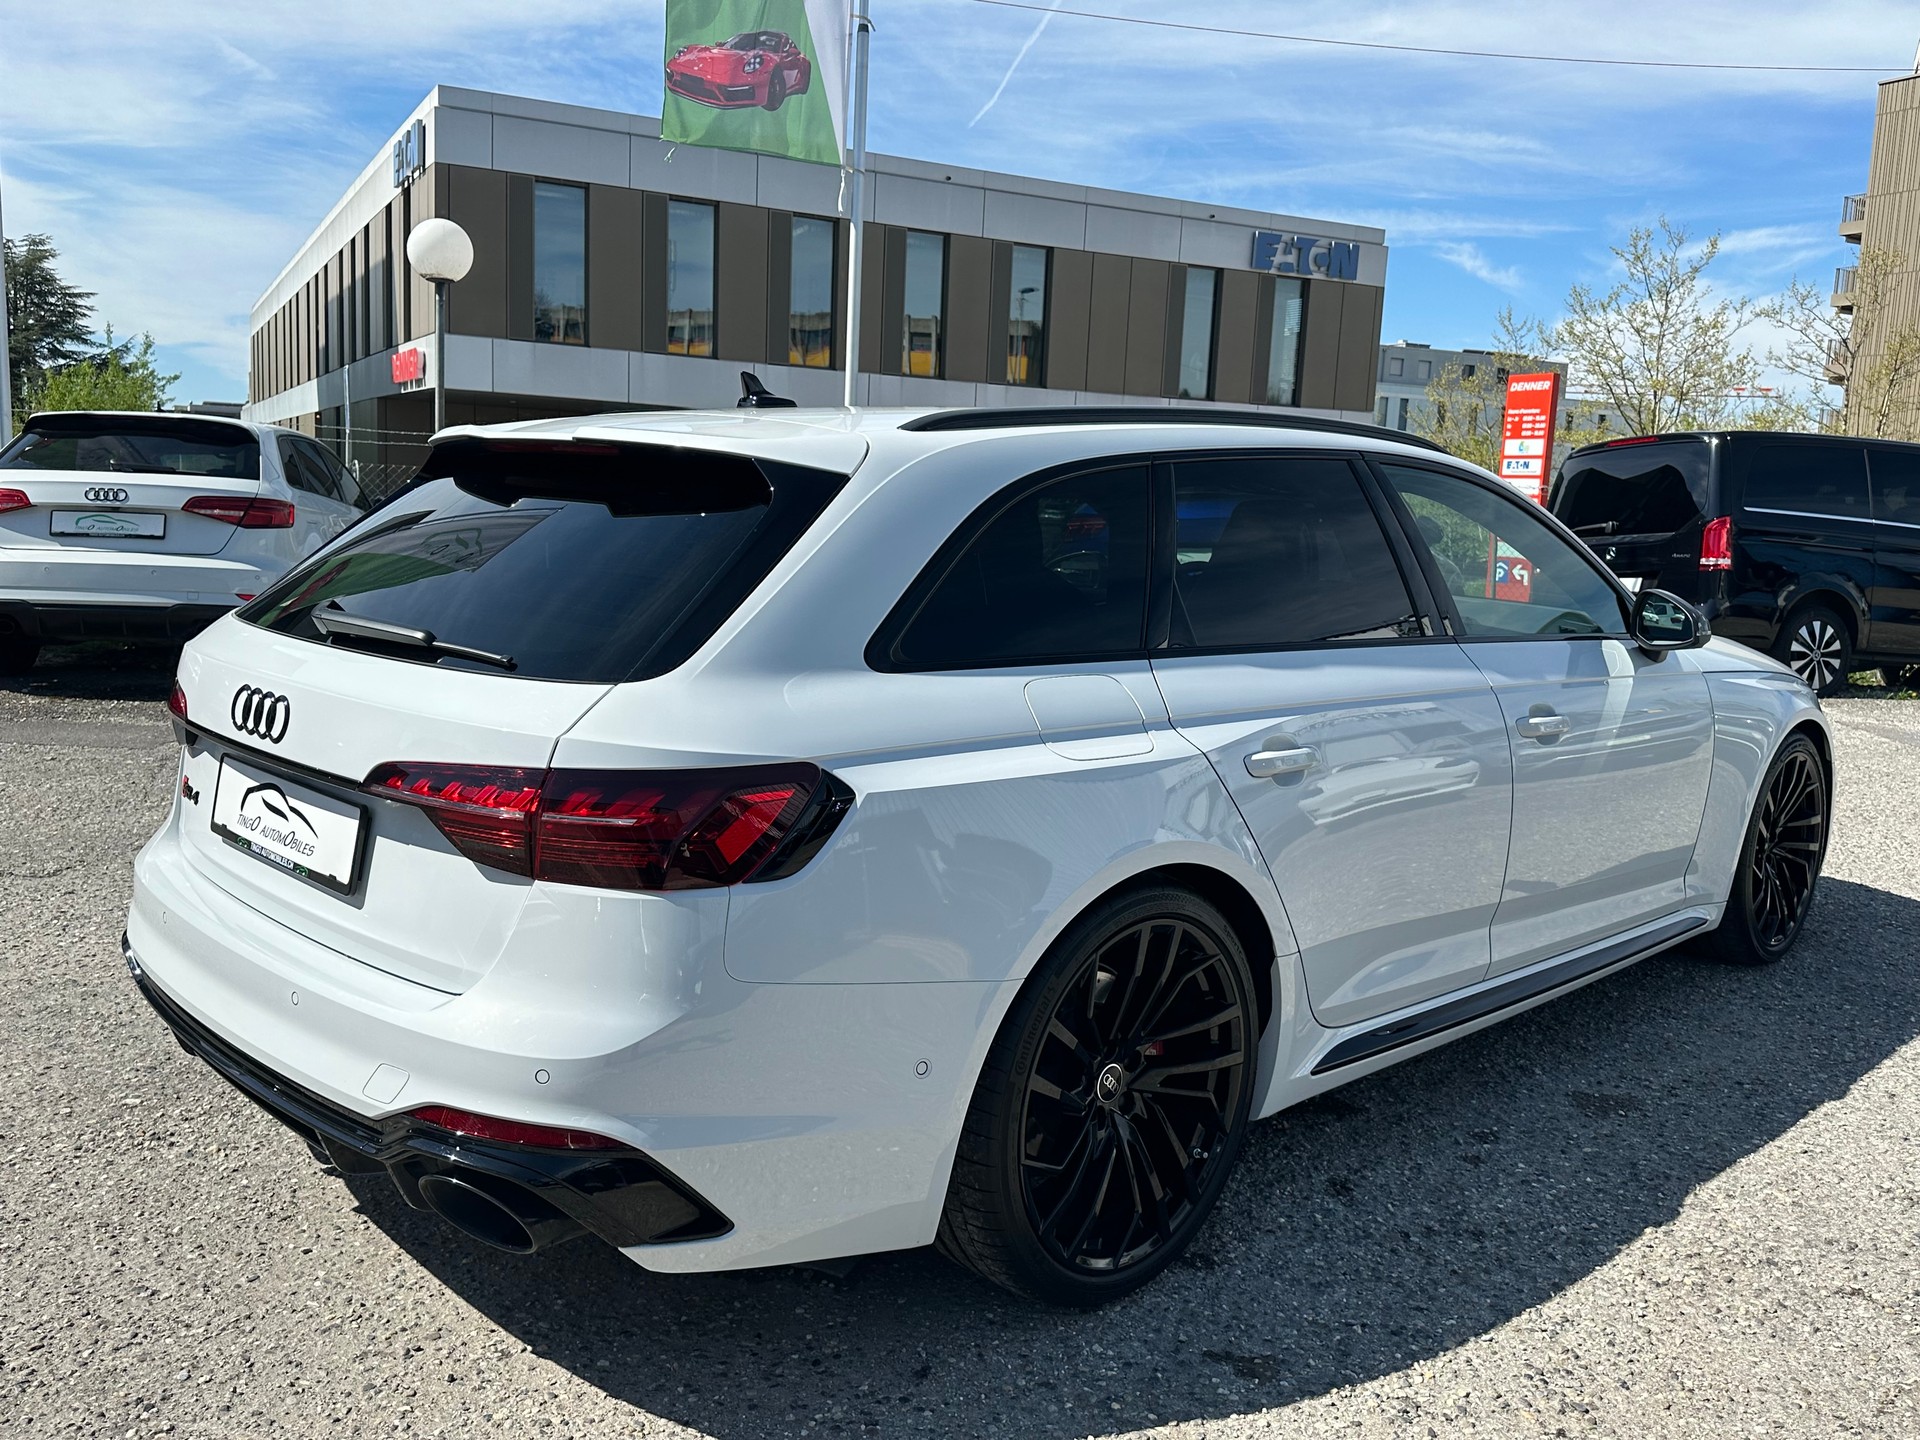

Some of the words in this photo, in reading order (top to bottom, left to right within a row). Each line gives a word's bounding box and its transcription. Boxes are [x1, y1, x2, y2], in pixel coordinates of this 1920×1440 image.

[1252, 230, 1360, 281] EATON
[1510, 381, 1551, 391] DENNER
[237, 814, 262, 832] TINGO
[260, 825, 316, 857] AUTOMOBILES
